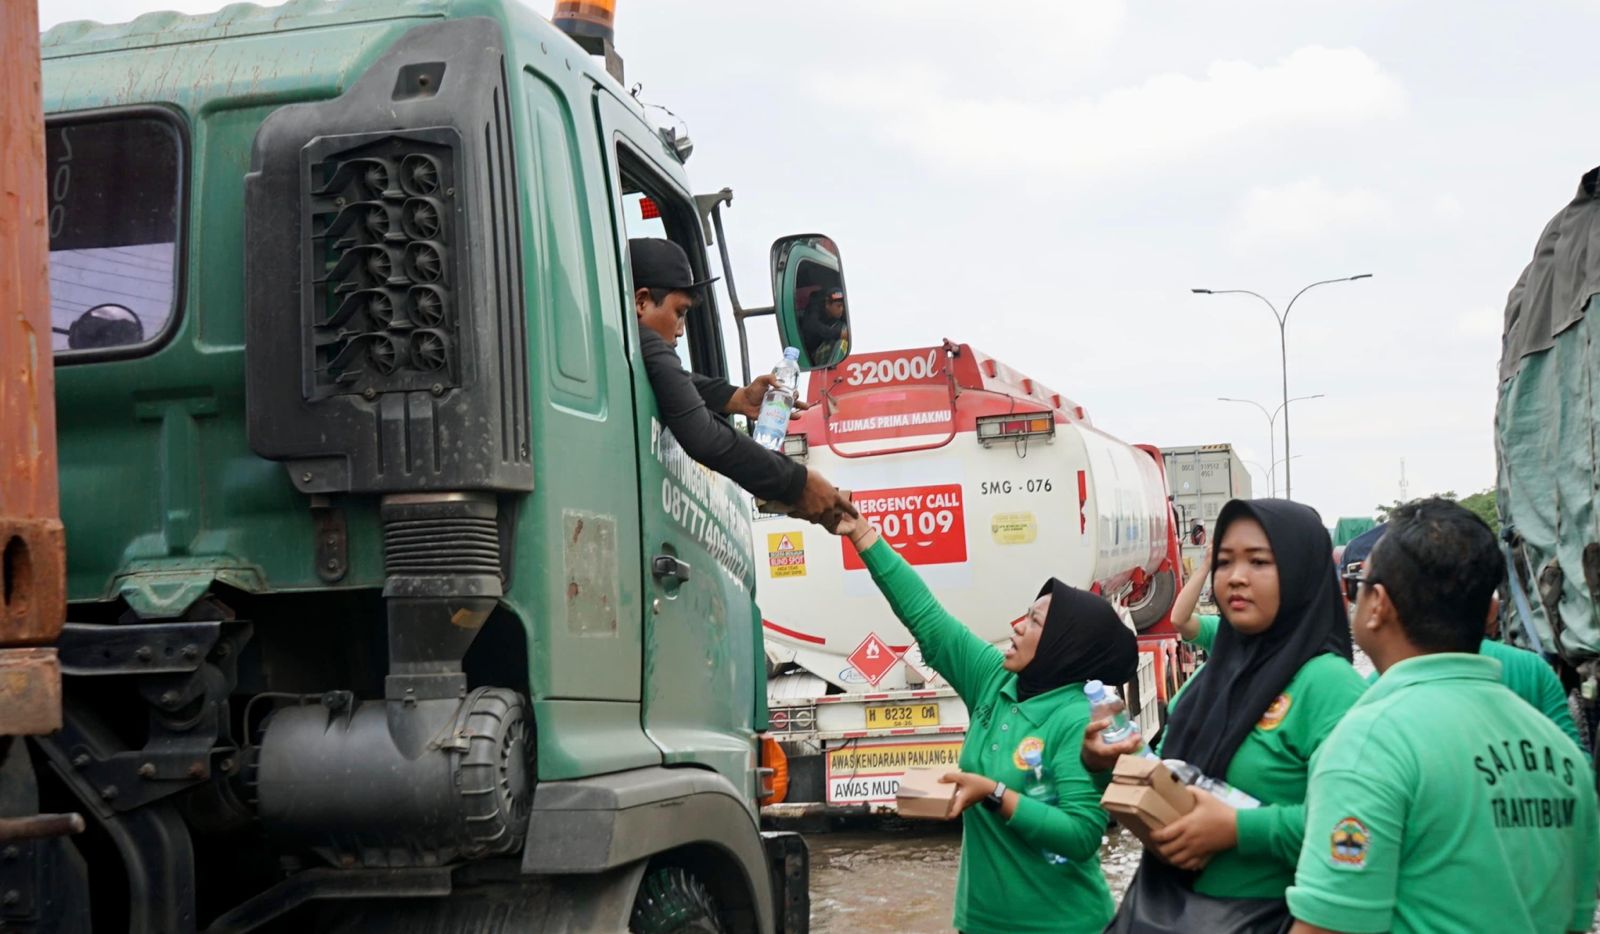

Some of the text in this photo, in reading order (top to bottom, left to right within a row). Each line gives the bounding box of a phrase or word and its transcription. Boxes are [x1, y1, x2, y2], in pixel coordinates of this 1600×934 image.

[842, 416, 879, 433] LUMAS
[878, 413, 909, 428] PRIMA
[912, 410, 951, 425] MAKMU
[981, 480, 1012, 495] SMG
[1026, 478, 1052, 493] 076
[851, 493, 959, 513] MERGENCY CALL
[867, 510, 953, 537] 50109
[869, 709, 876, 721] H
[885, 707, 912, 720] 8232
[832, 755, 855, 769] AWAS
[855, 752, 906, 769] KENDARAAN
[908, 750, 946, 766] PANJANG
[948, 751, 954, 763] &
[835, 780, 899, 797] AWAS MUD
